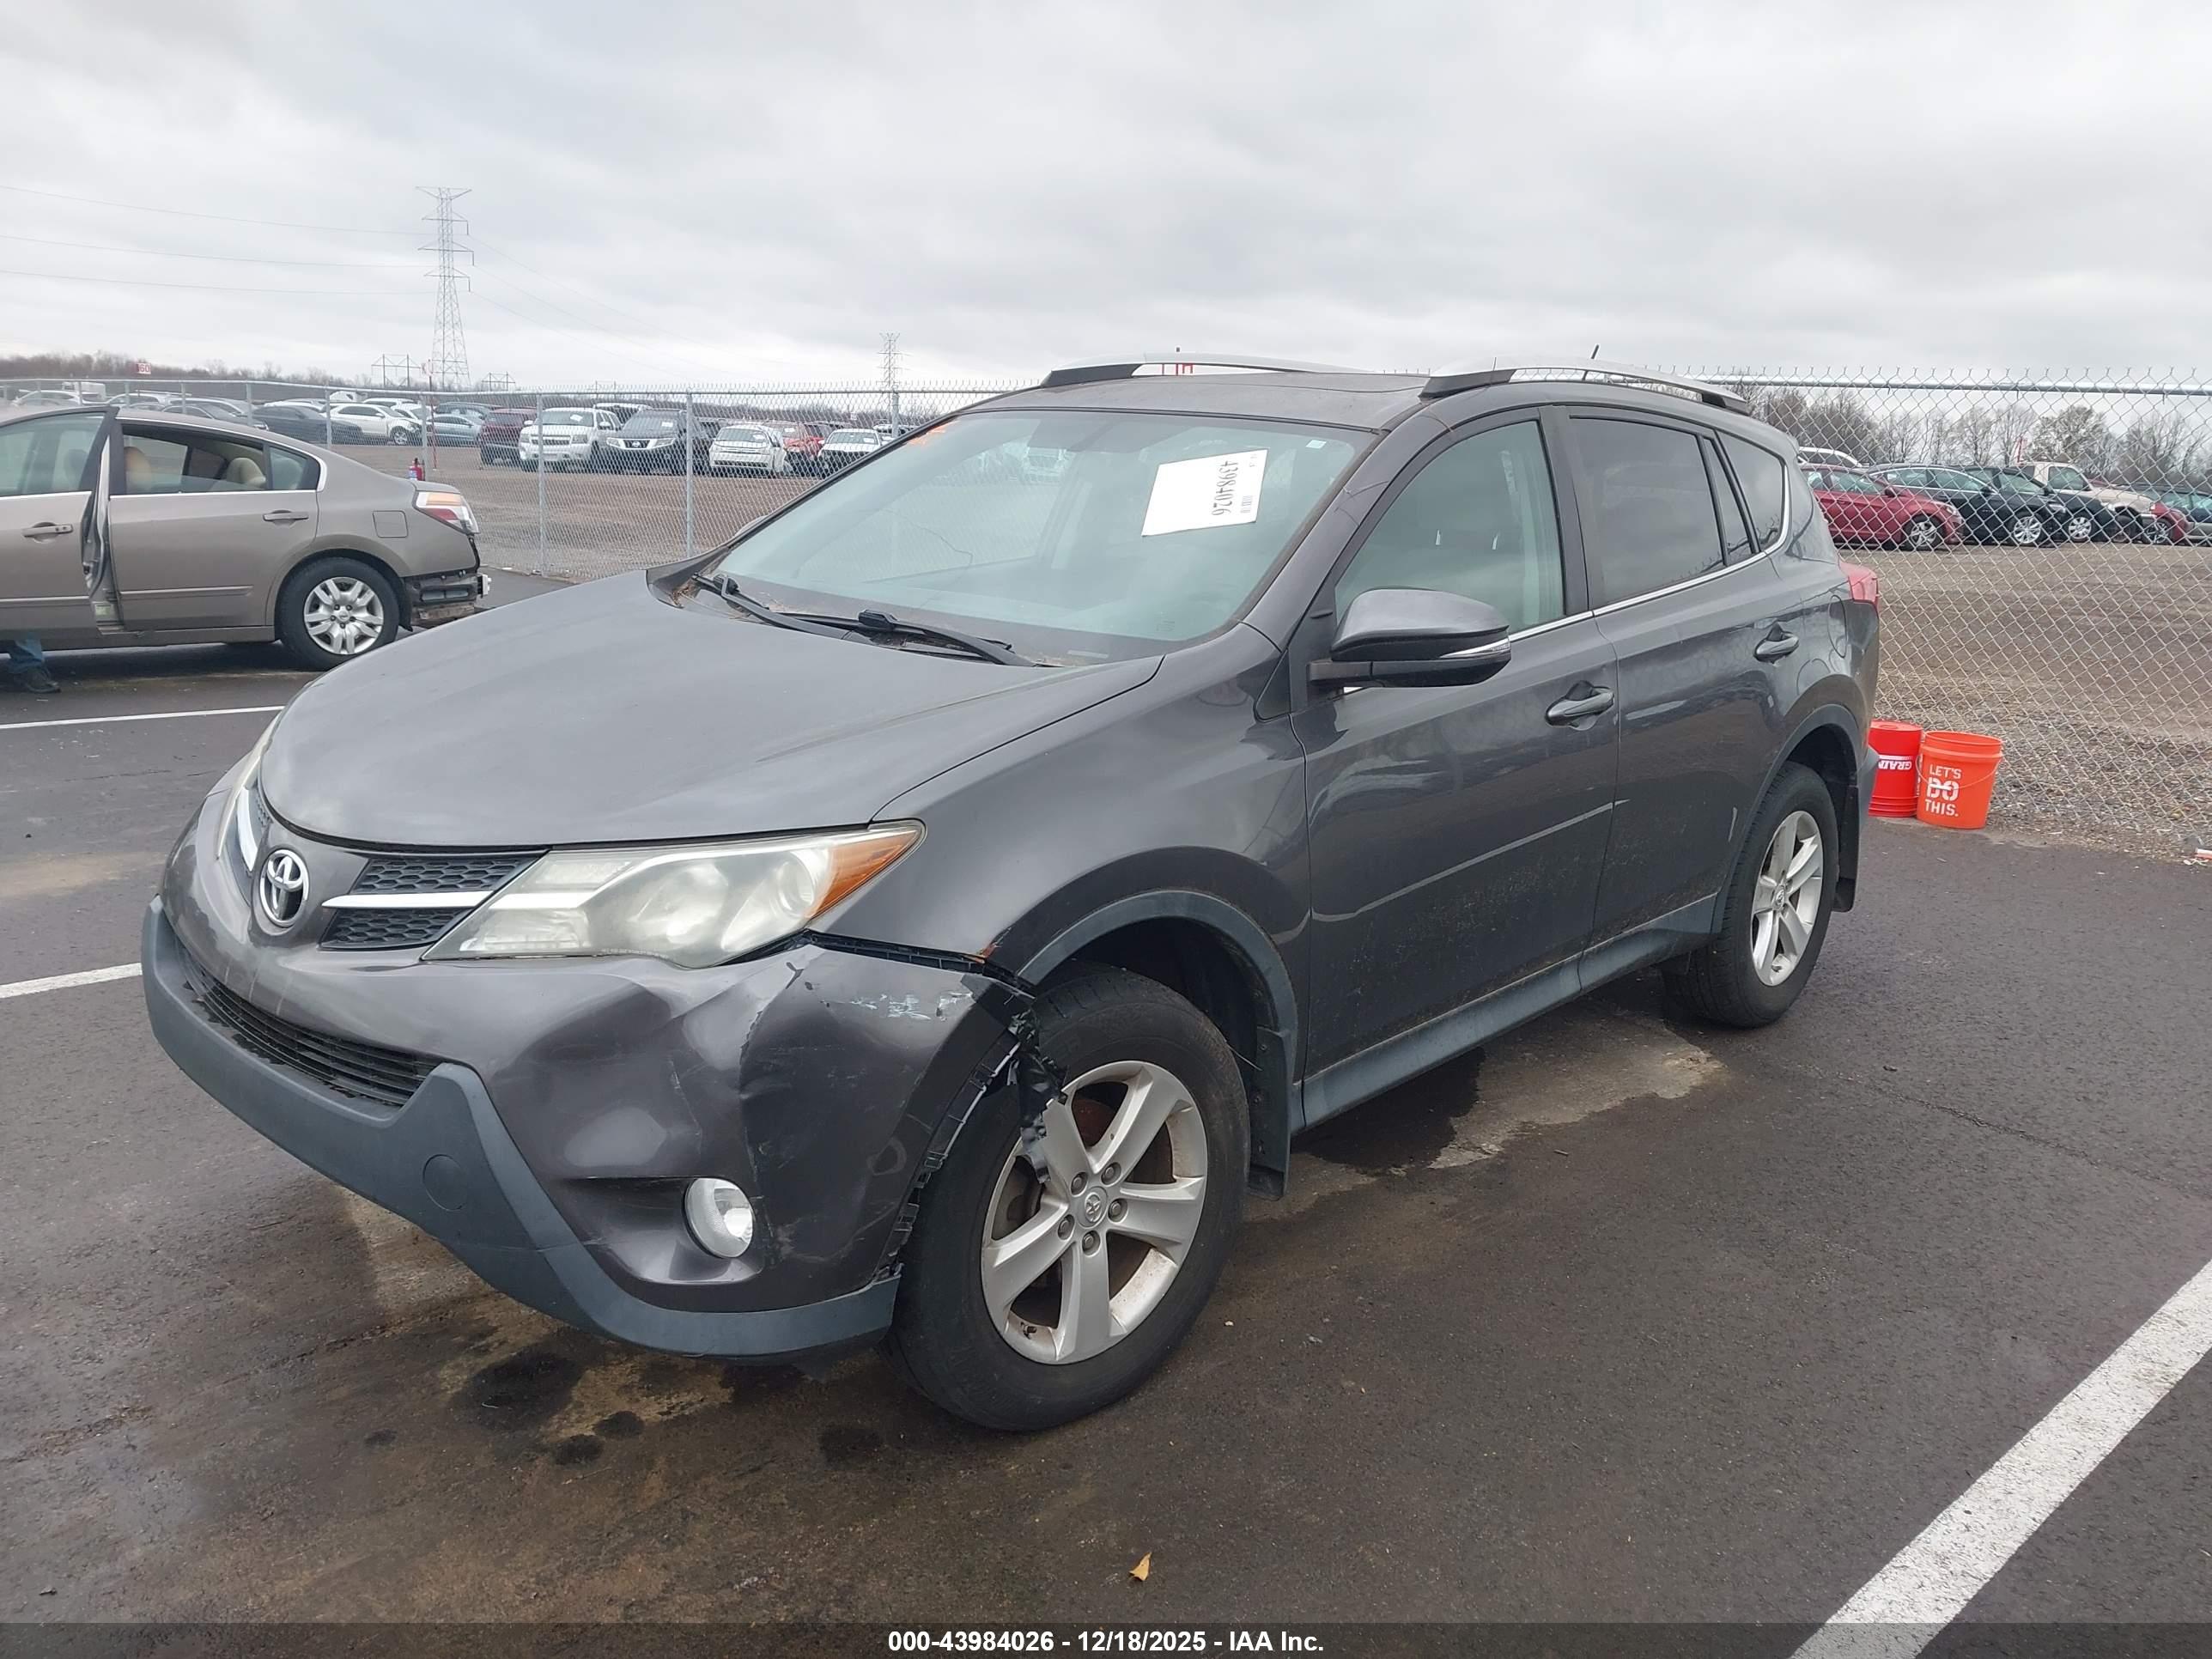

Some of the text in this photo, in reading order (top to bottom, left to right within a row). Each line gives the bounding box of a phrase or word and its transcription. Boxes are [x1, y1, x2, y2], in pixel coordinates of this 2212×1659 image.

[1212, 460, 1238, 515] 43984026
[1929, 763, 1962, 779] LET'S
[1926, 777, 1960, 801] DO
[1925, 799, 1959, 817] THIS.
